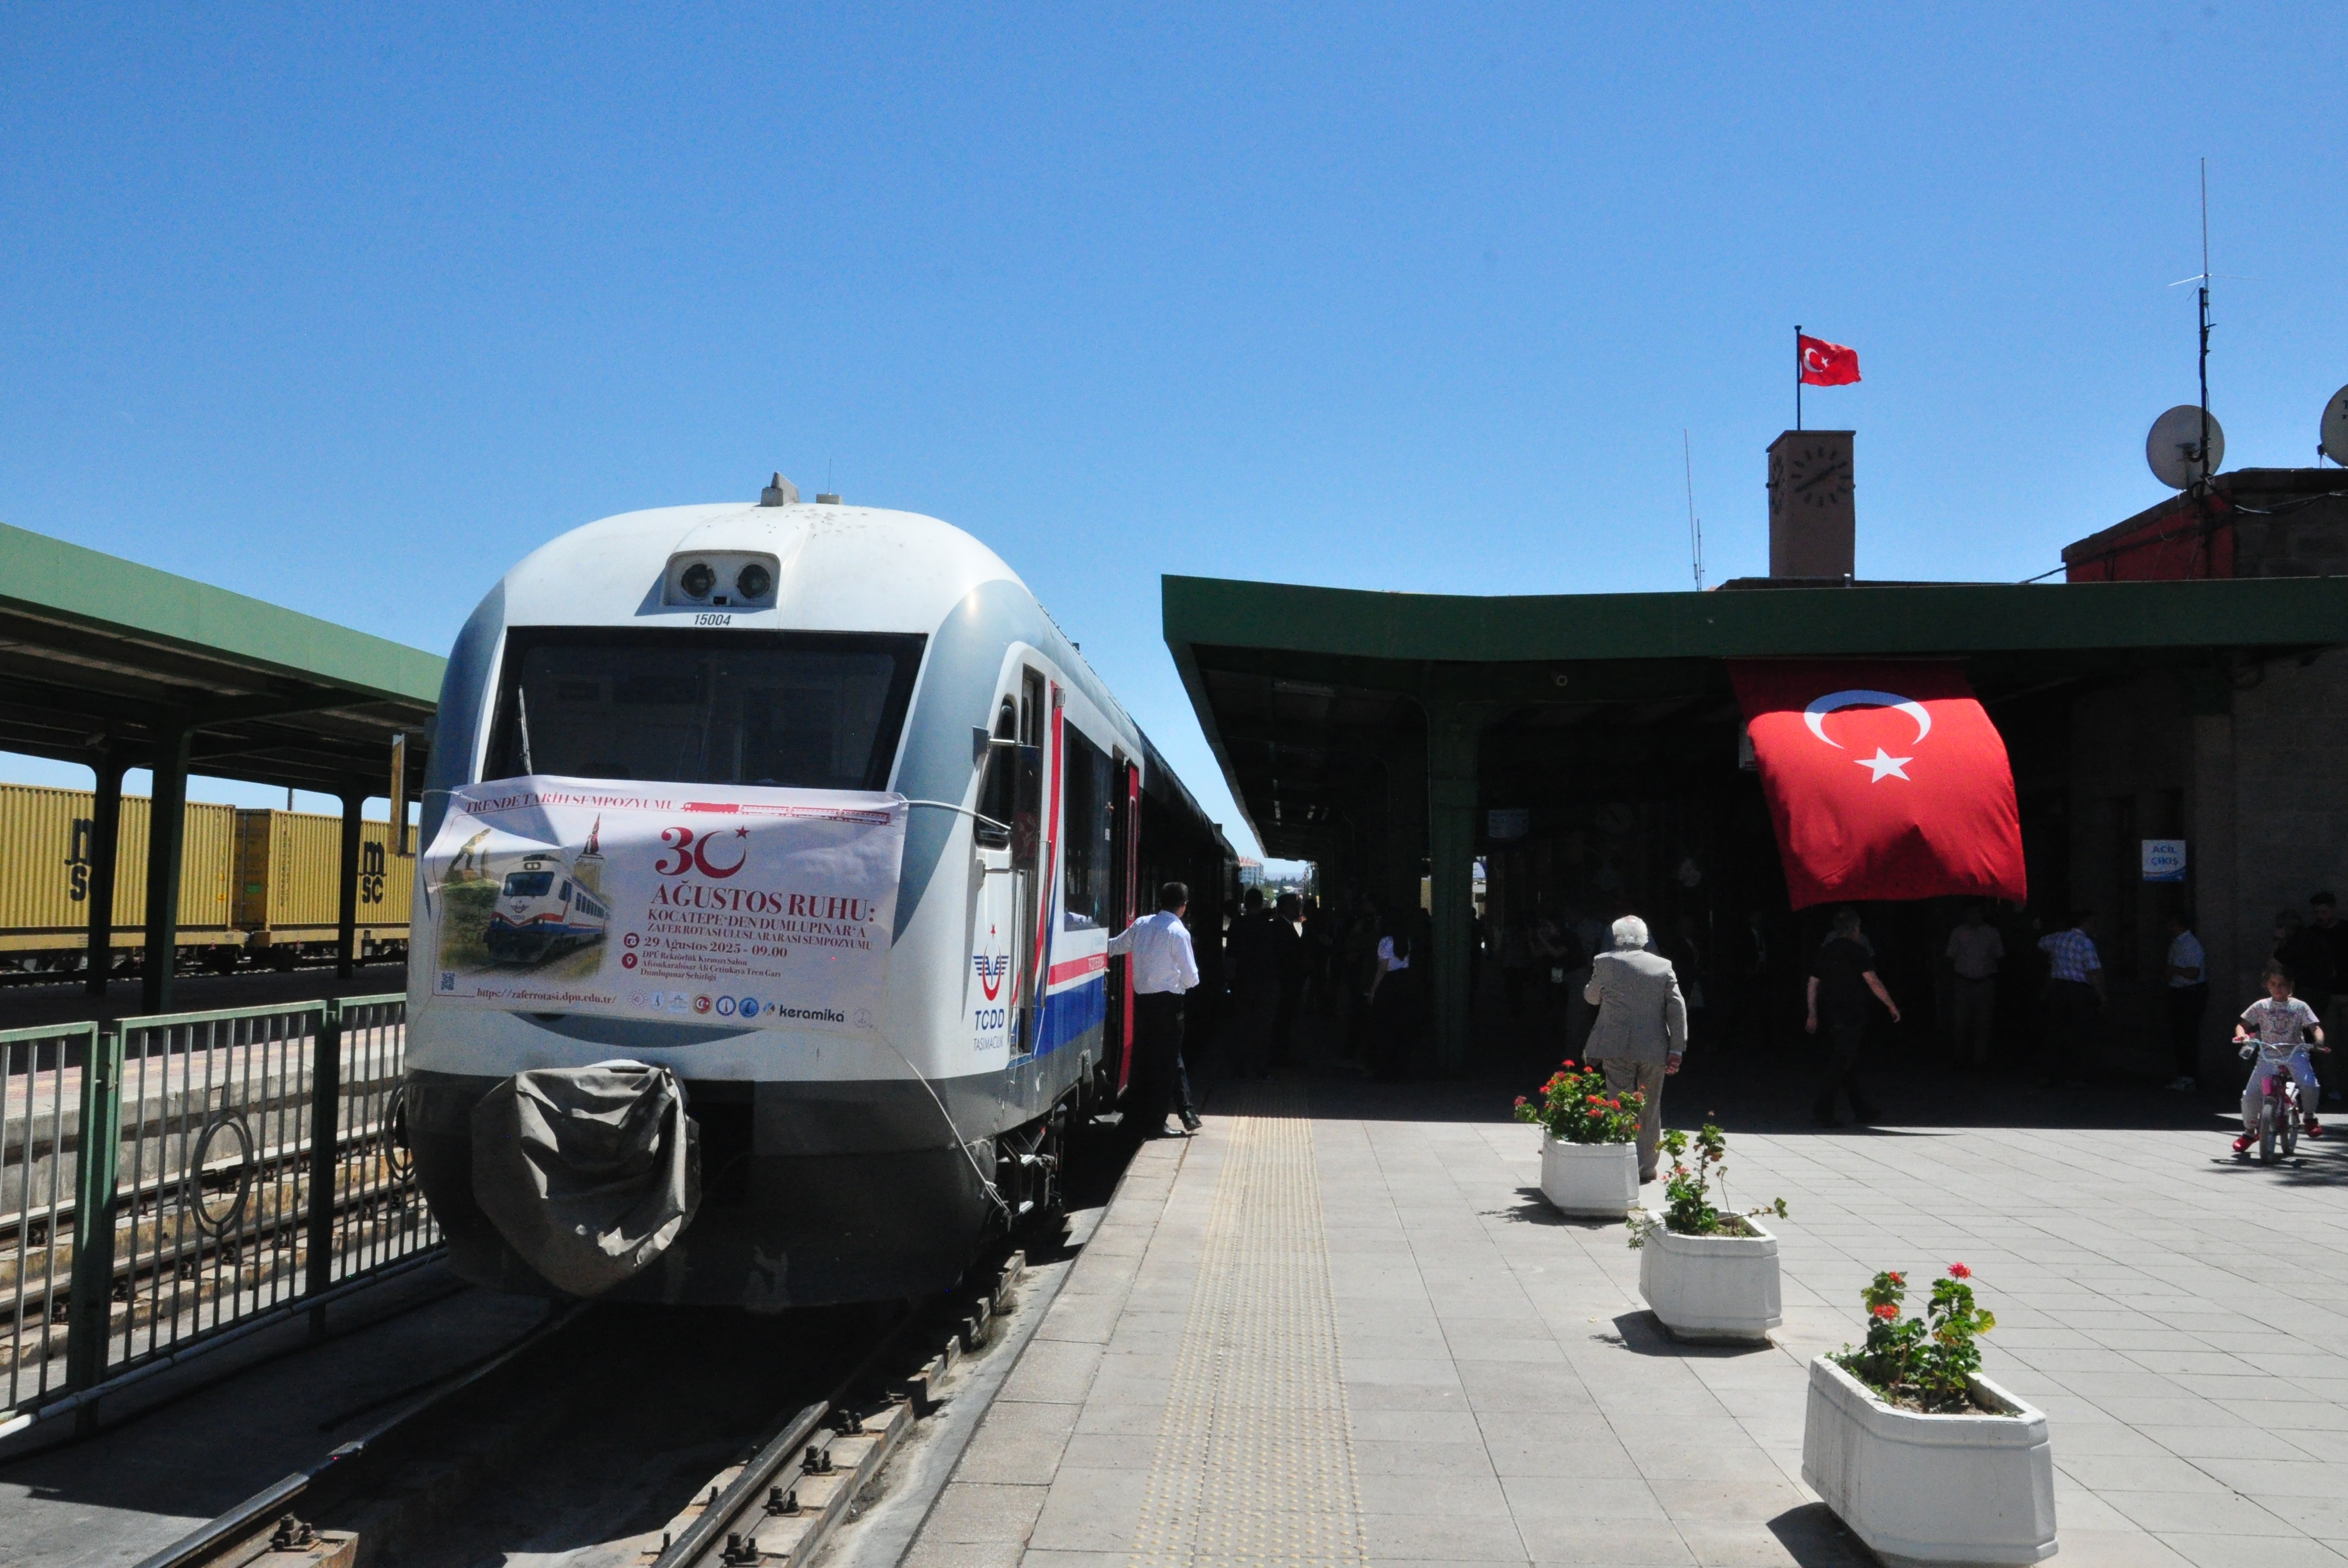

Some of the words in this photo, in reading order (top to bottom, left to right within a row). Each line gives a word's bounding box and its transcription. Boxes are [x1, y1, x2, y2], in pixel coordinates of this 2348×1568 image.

[694, 613, 732, 626] 15004
[465, 793, 521, 813] TRENDE
[523, 792, 570, 806] TARİH
[572, 795, 676, 810] SEMPOZYUMU
[2150, 856, 2179, 866] ÇIKIŞ
[651, 880, 782, 915] AĞUSTOS
[788, 893, 875, 923] RUHU:
[647, 923, 681, 934] ZAFER
[683, 925, 721, 937] ROTASI
[723, 928, 802, 944] ULUSLARARASI
[803, 935, 873, 950] SEMPOZYUMU
[644, 937, 660, 947] 29
[662, 938, 708, 952] Ağustos
[710, 941, 741, 954] 2025
[751, 945, 788, 957] 09.00
[643, 960, 697, 970] Afyonkarahisar
[779, 1004, 845, 1023] keramika
[975, 1009, 1005, 1031] TCDD
